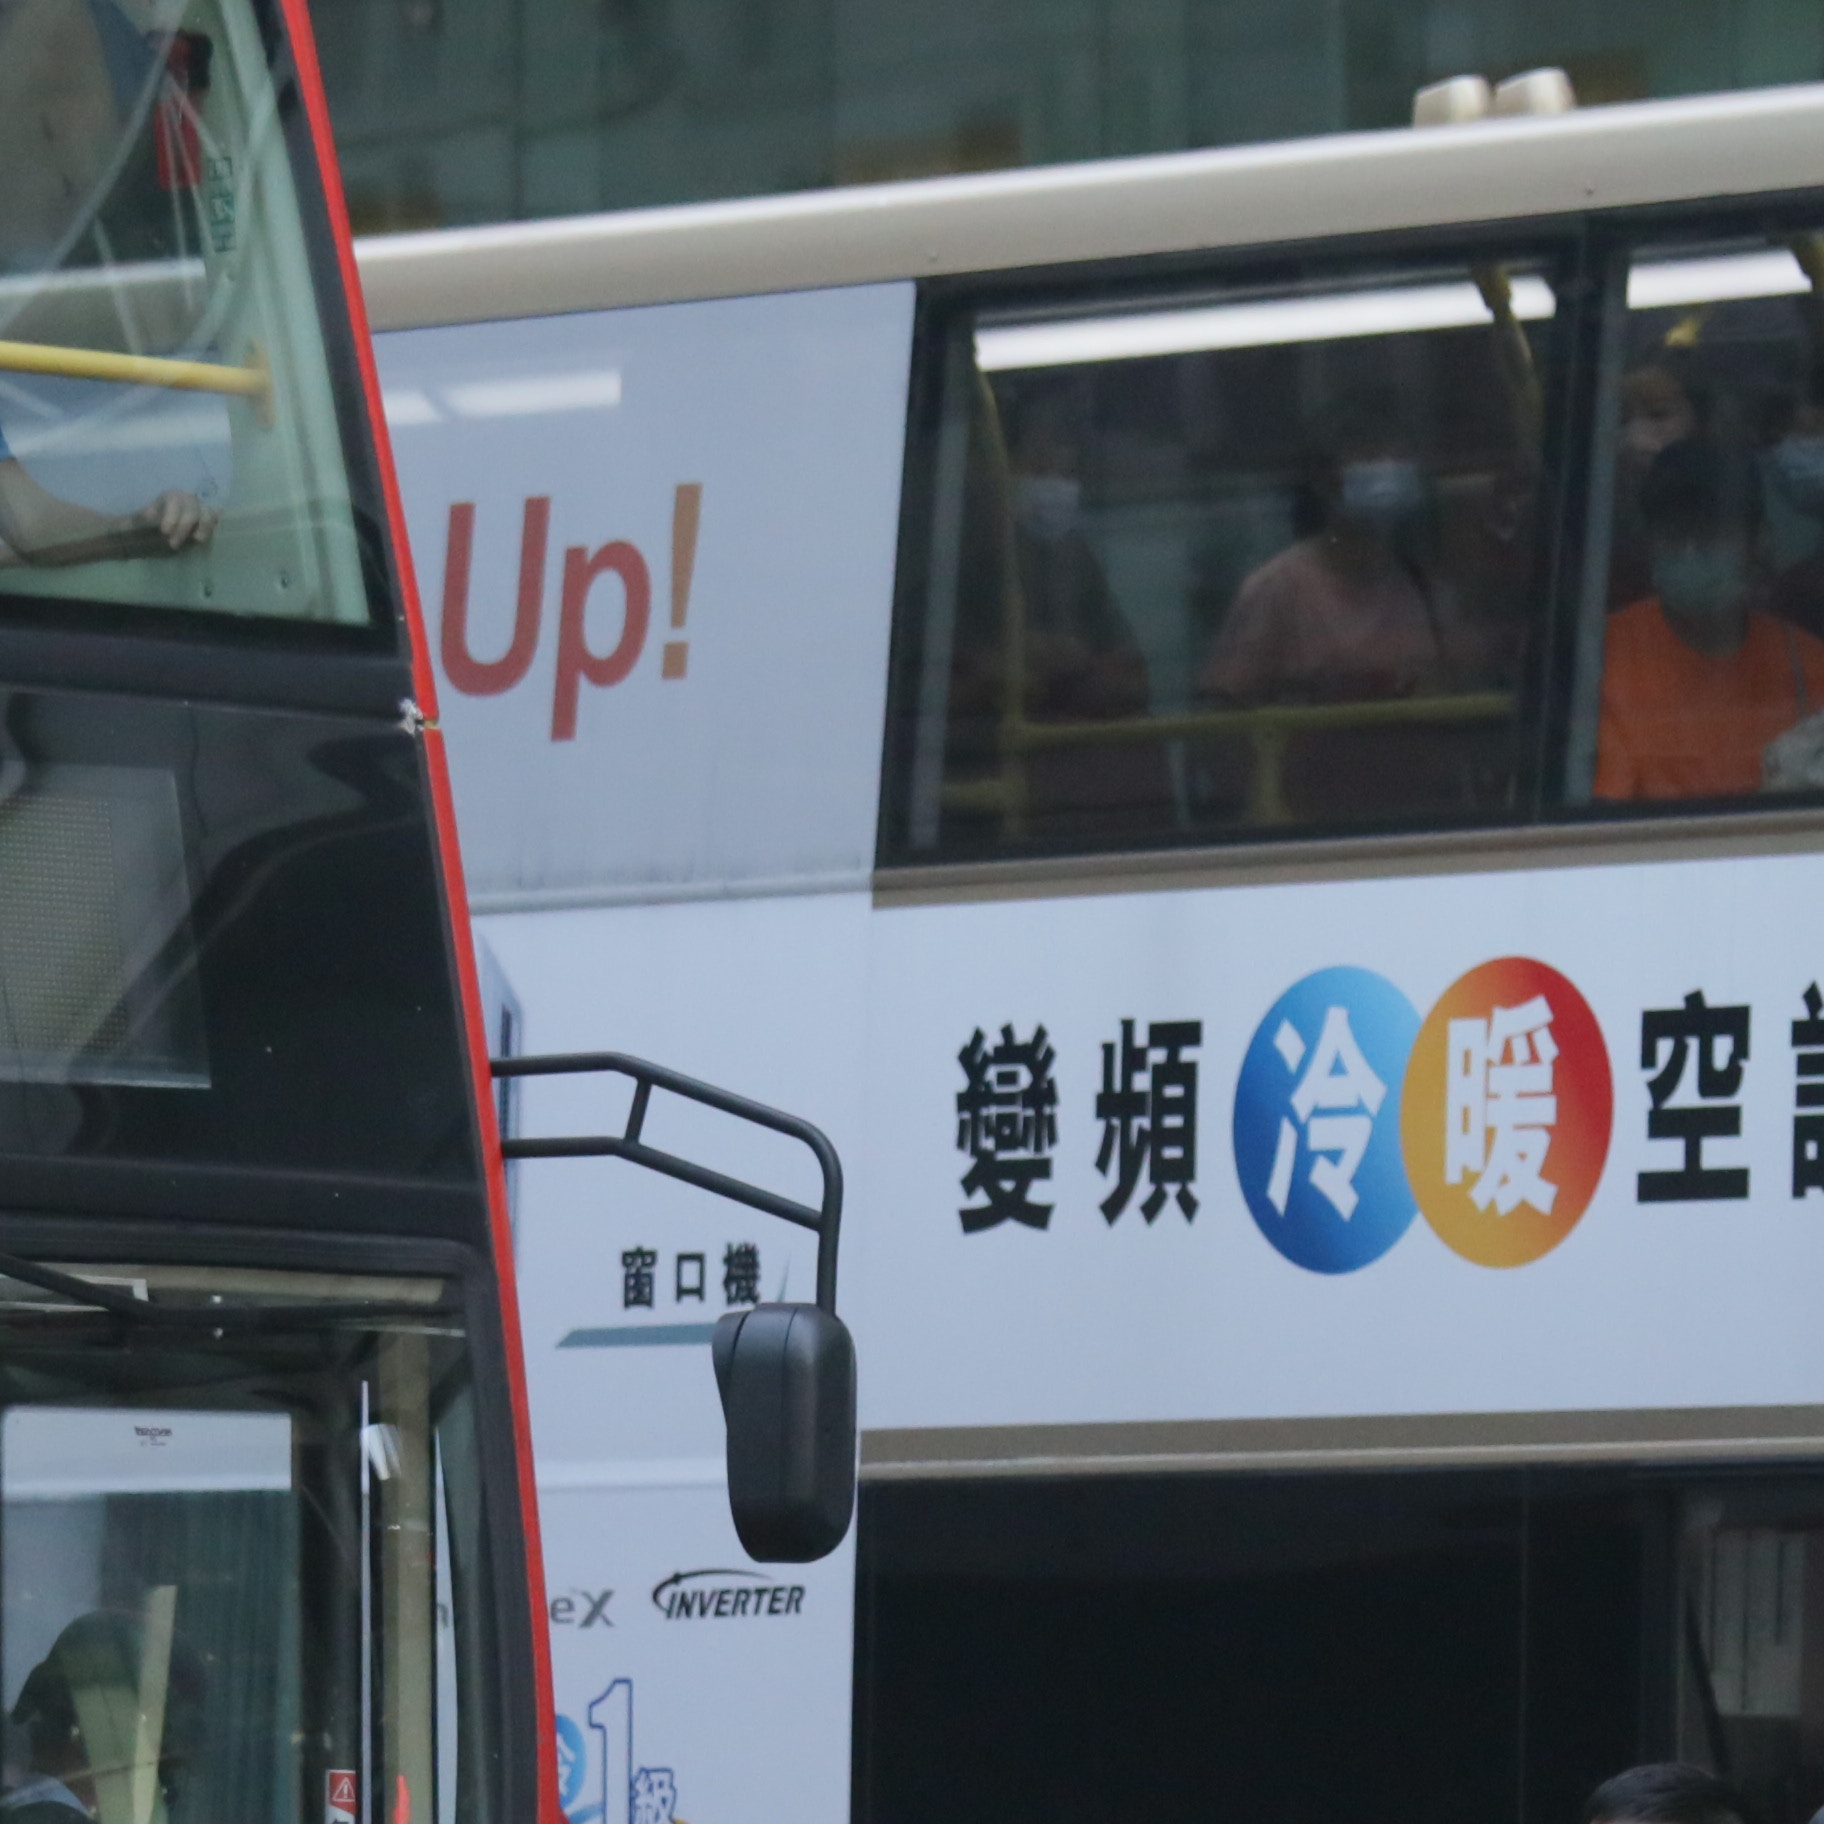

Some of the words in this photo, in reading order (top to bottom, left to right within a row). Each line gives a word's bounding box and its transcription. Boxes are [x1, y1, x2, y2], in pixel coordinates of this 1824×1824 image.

[440, 482, 703, 742] Up!
[622, 1243, 760, 1309] 窗口機
[664, 1584, 806, 1620] INVERTER
